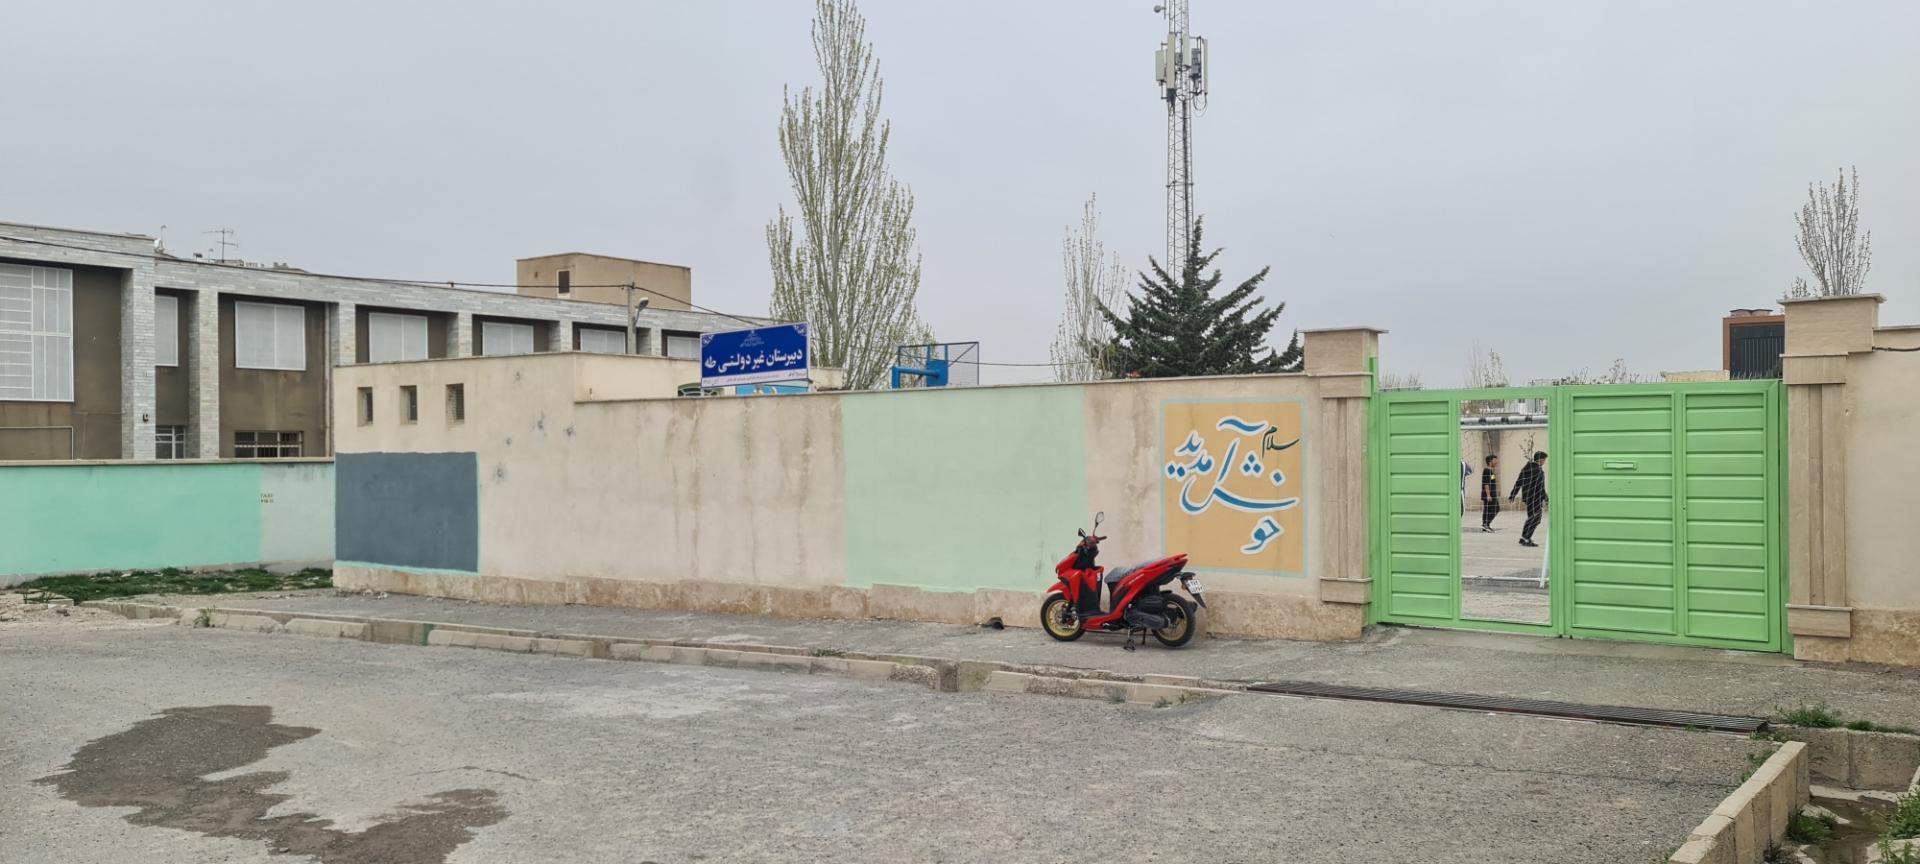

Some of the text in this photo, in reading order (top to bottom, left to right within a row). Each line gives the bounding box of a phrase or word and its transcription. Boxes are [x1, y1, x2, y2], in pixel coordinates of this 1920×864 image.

[704, 348, 803, 373] دبیرستان غیر دولتی طه
[1262, 426, 1300, 459] سلام
[1165, 417, 1299, 554] خوش آمدید
